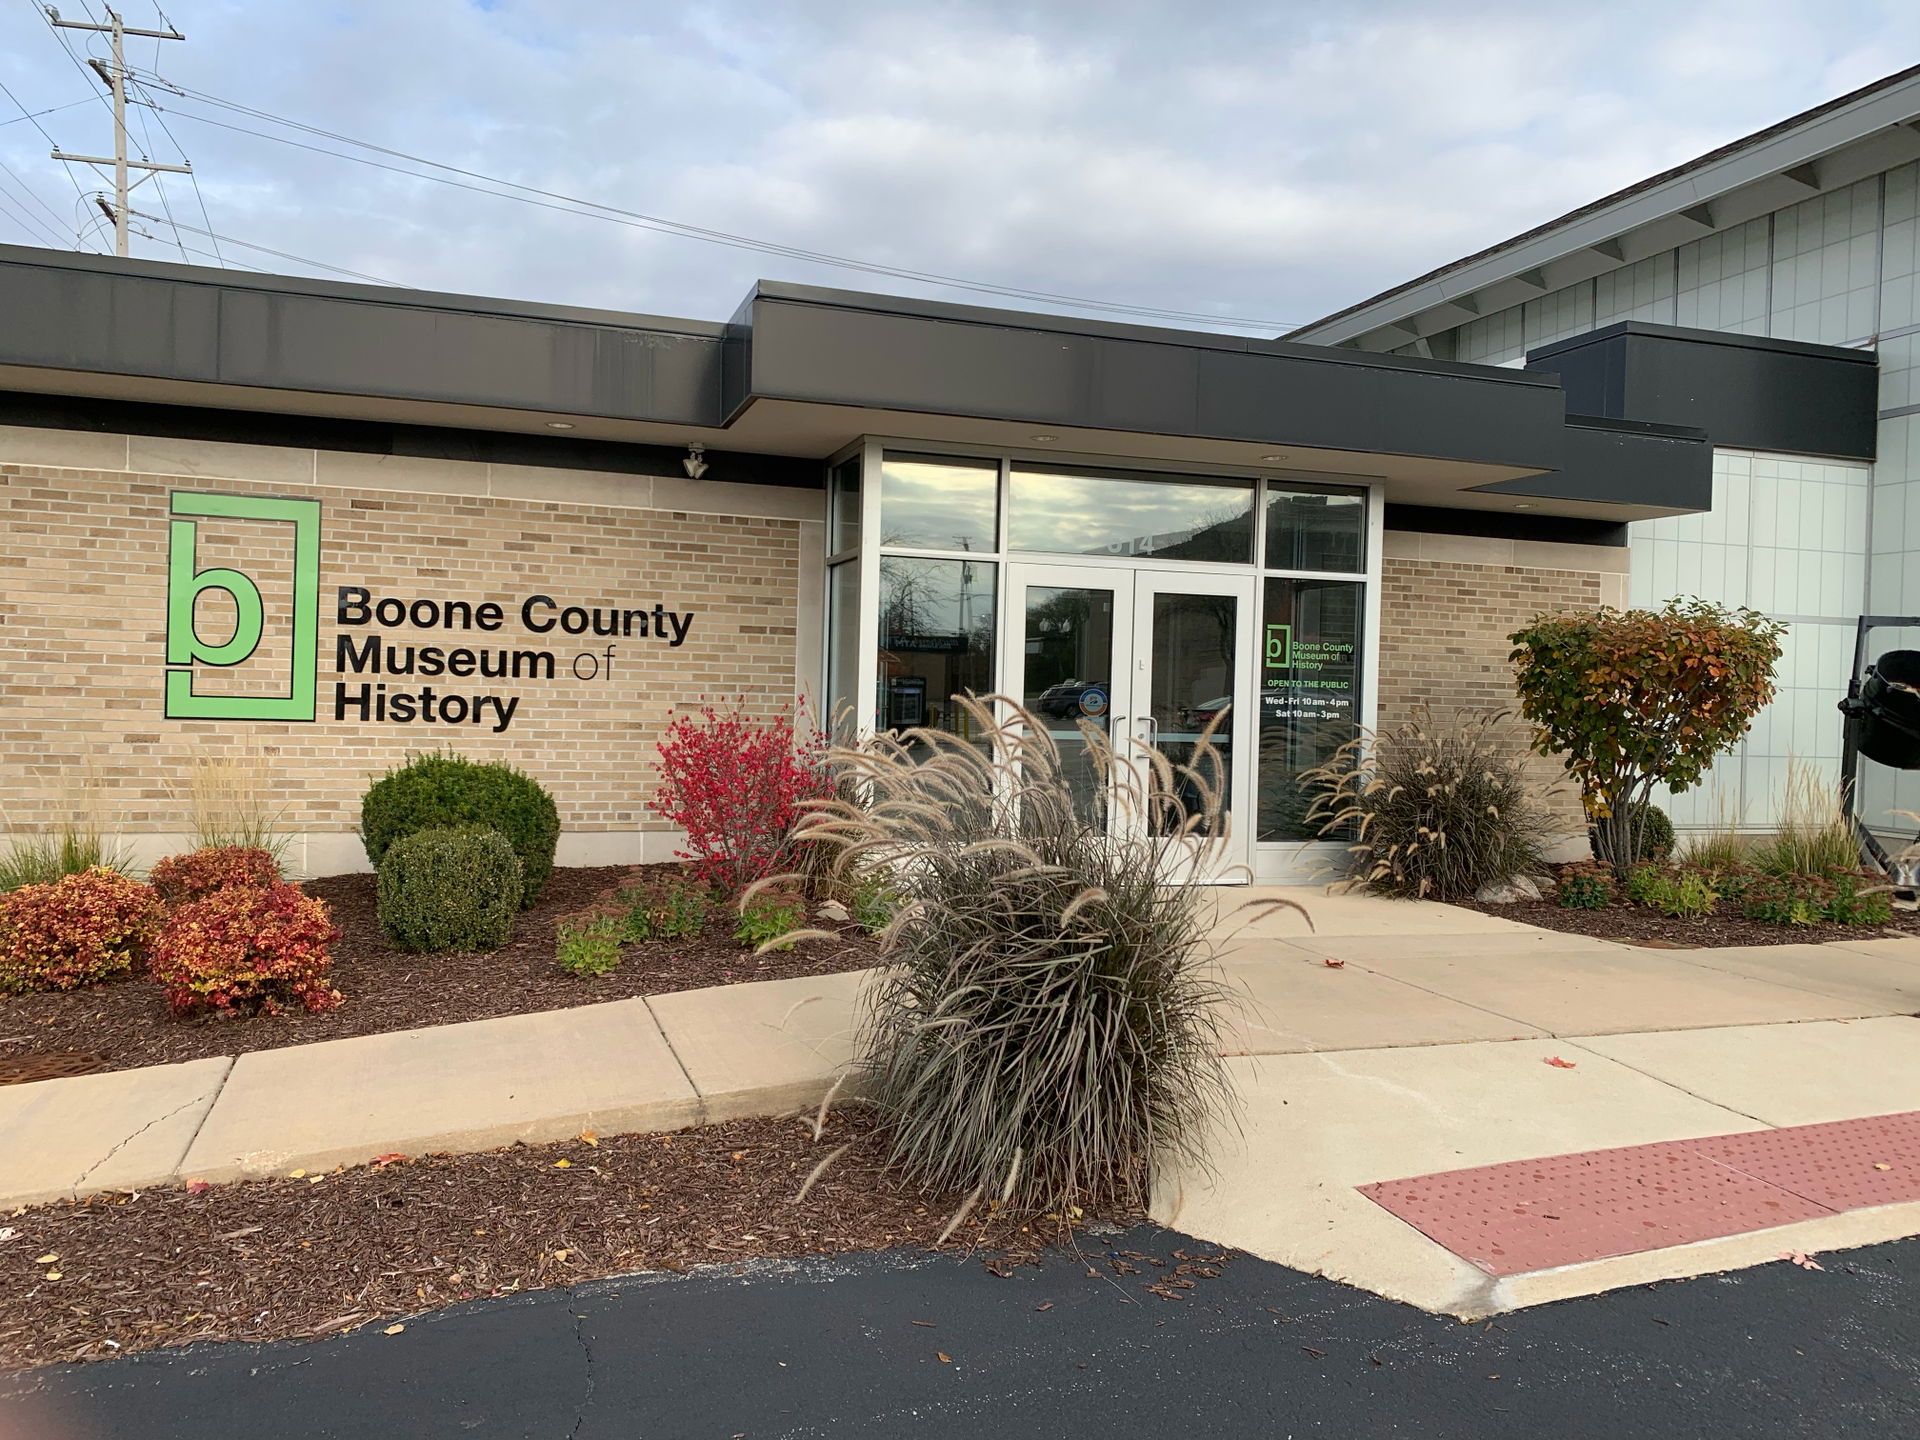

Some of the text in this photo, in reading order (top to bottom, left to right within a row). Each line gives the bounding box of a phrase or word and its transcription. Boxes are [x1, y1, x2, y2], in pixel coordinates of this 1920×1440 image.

[337, 585, 694, 647] Boone County
[1292, 641, 1354, 653] Boone County
[336, 634, 616, 681] Museum of
[1292, 651, 1340, 661] Museum of
[1292, 660, 1323, 671] History
[1267, 679, 1290, 687] OPEN
[1304, 680, 1319, 688] THE
[1320, 681, 1349, 689] PUBLIC
[335, 682, 520, 732] History
[1275, 709, 1292, 718] Sat
